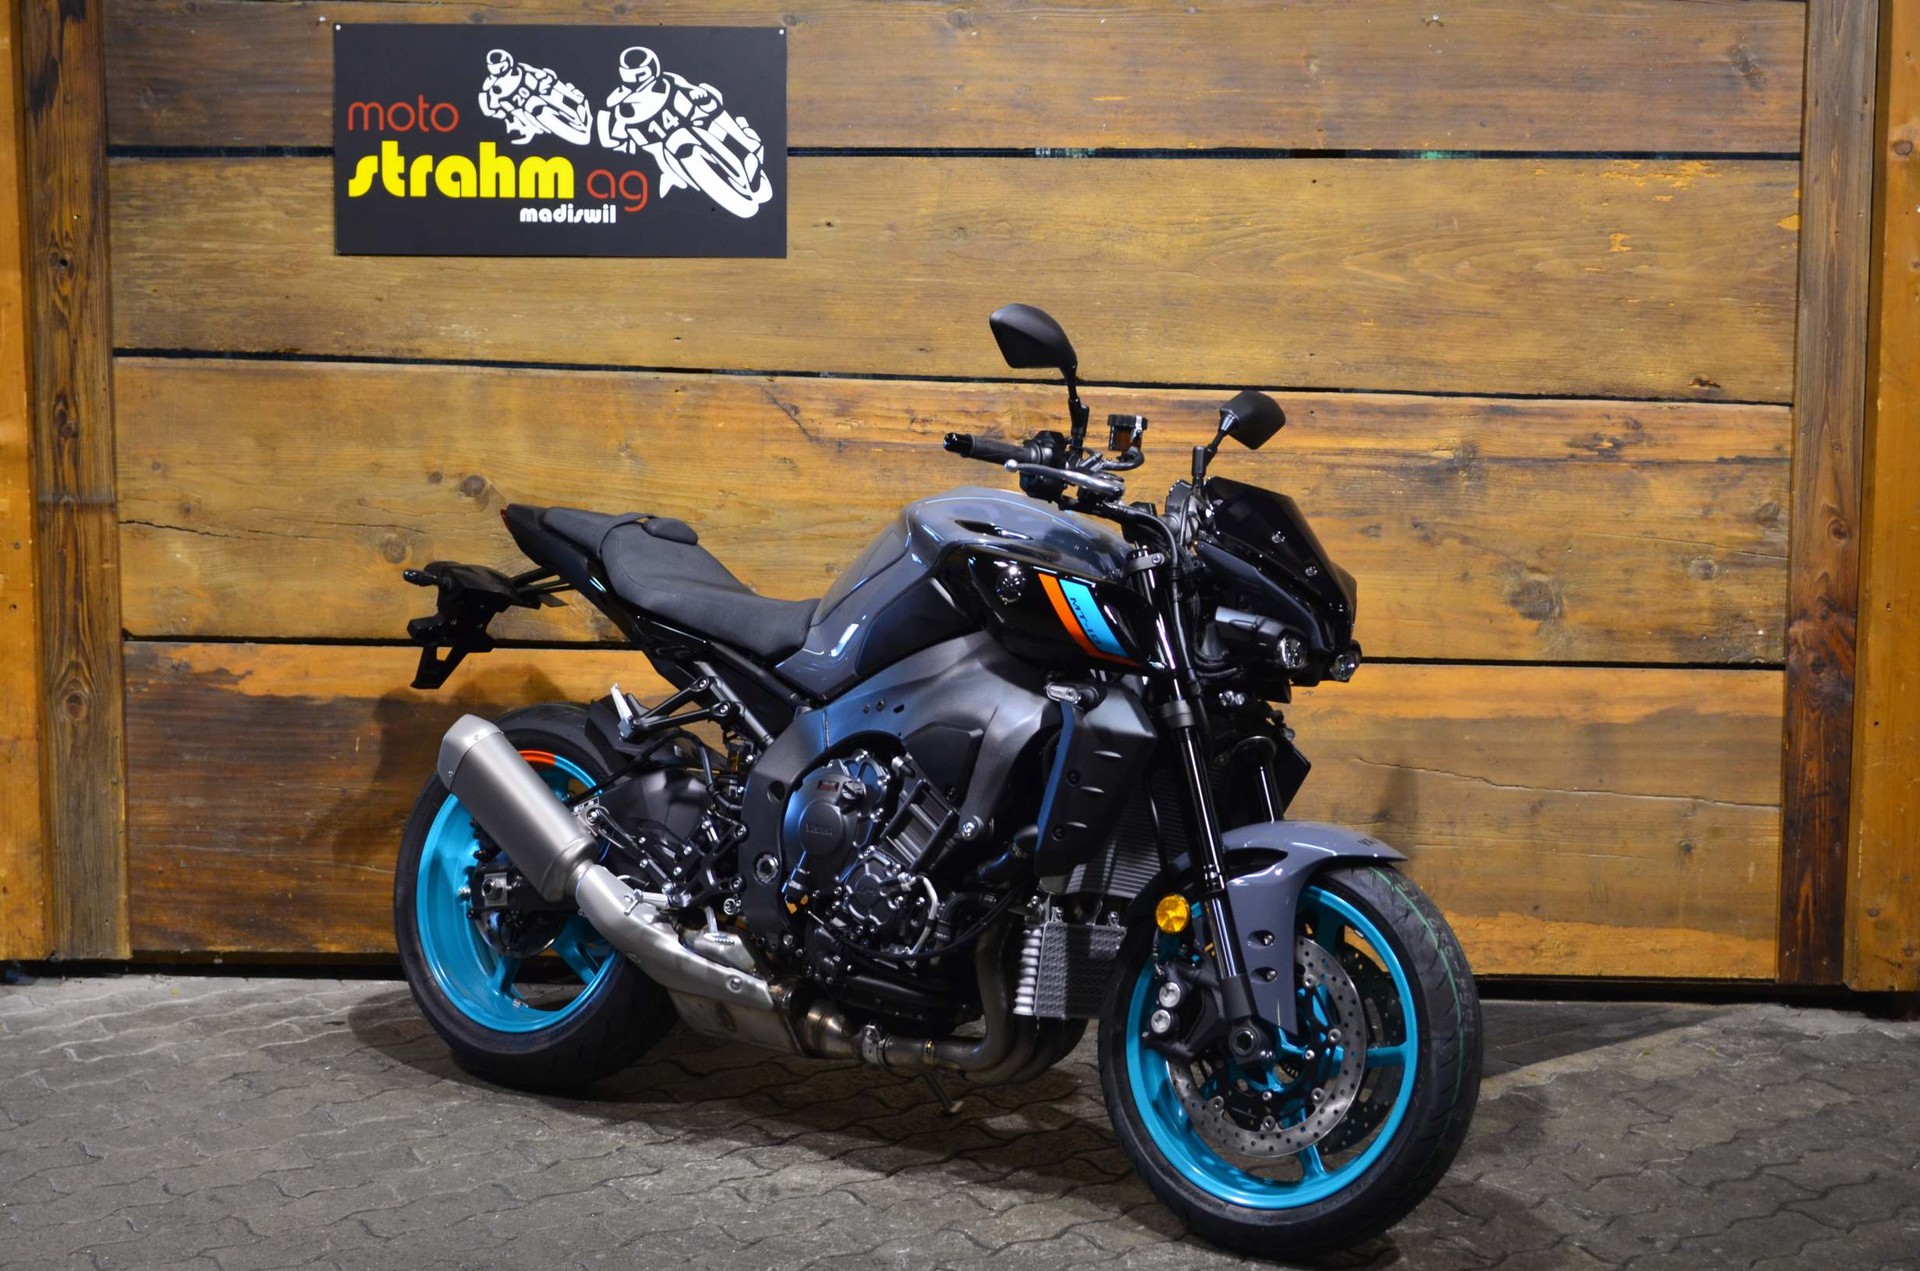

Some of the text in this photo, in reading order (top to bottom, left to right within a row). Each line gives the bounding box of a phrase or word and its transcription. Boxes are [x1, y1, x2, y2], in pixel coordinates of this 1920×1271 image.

[347, 94, 460, 133] moto
[512, 87, 530, 107] 20
[648, 109, 680, 139] 14
[348, 140, 649, 213] strahm ag
[519, 203, 617, 224] madiswil
[1070, 597, 1102, 645] MT-10
